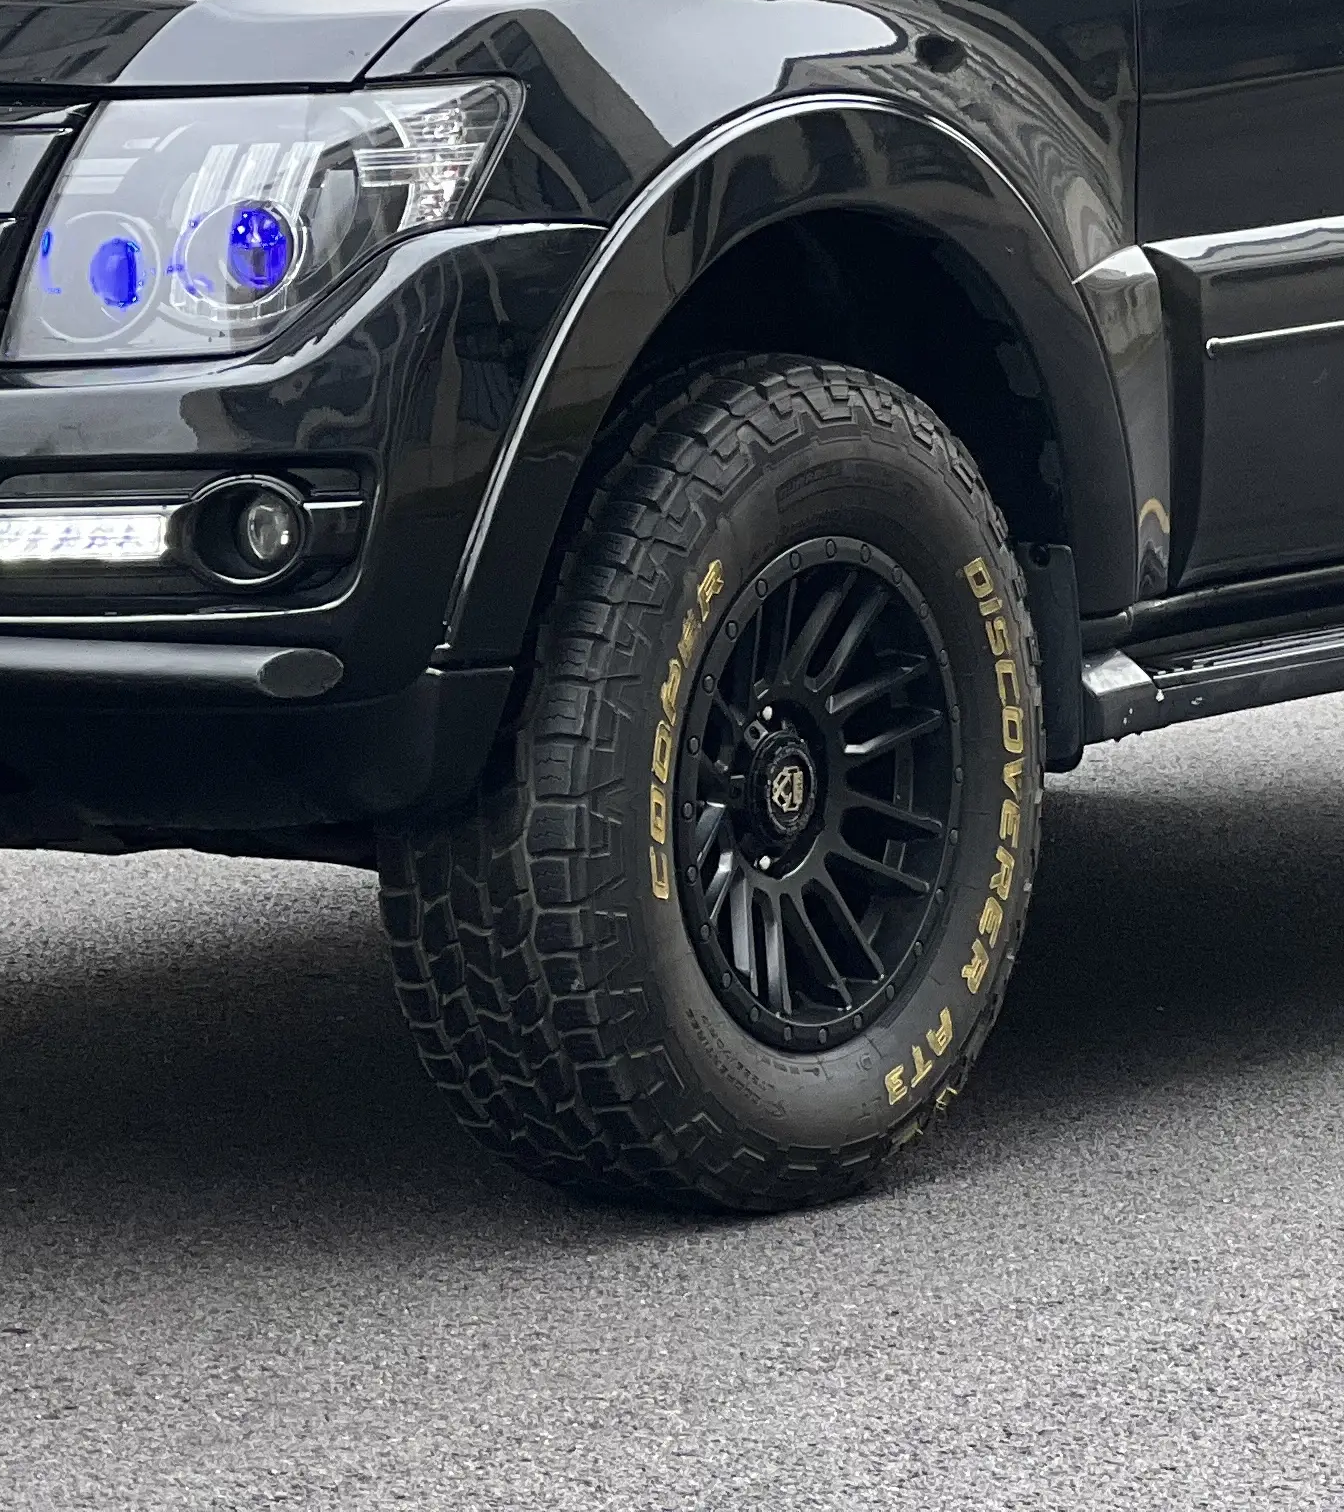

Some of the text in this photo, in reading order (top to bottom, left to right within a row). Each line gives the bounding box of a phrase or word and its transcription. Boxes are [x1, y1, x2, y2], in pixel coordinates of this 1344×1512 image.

[651, 559, 724, 900] COOPER
[885, 556, 1026, 1106] DISCOVERER AT3
